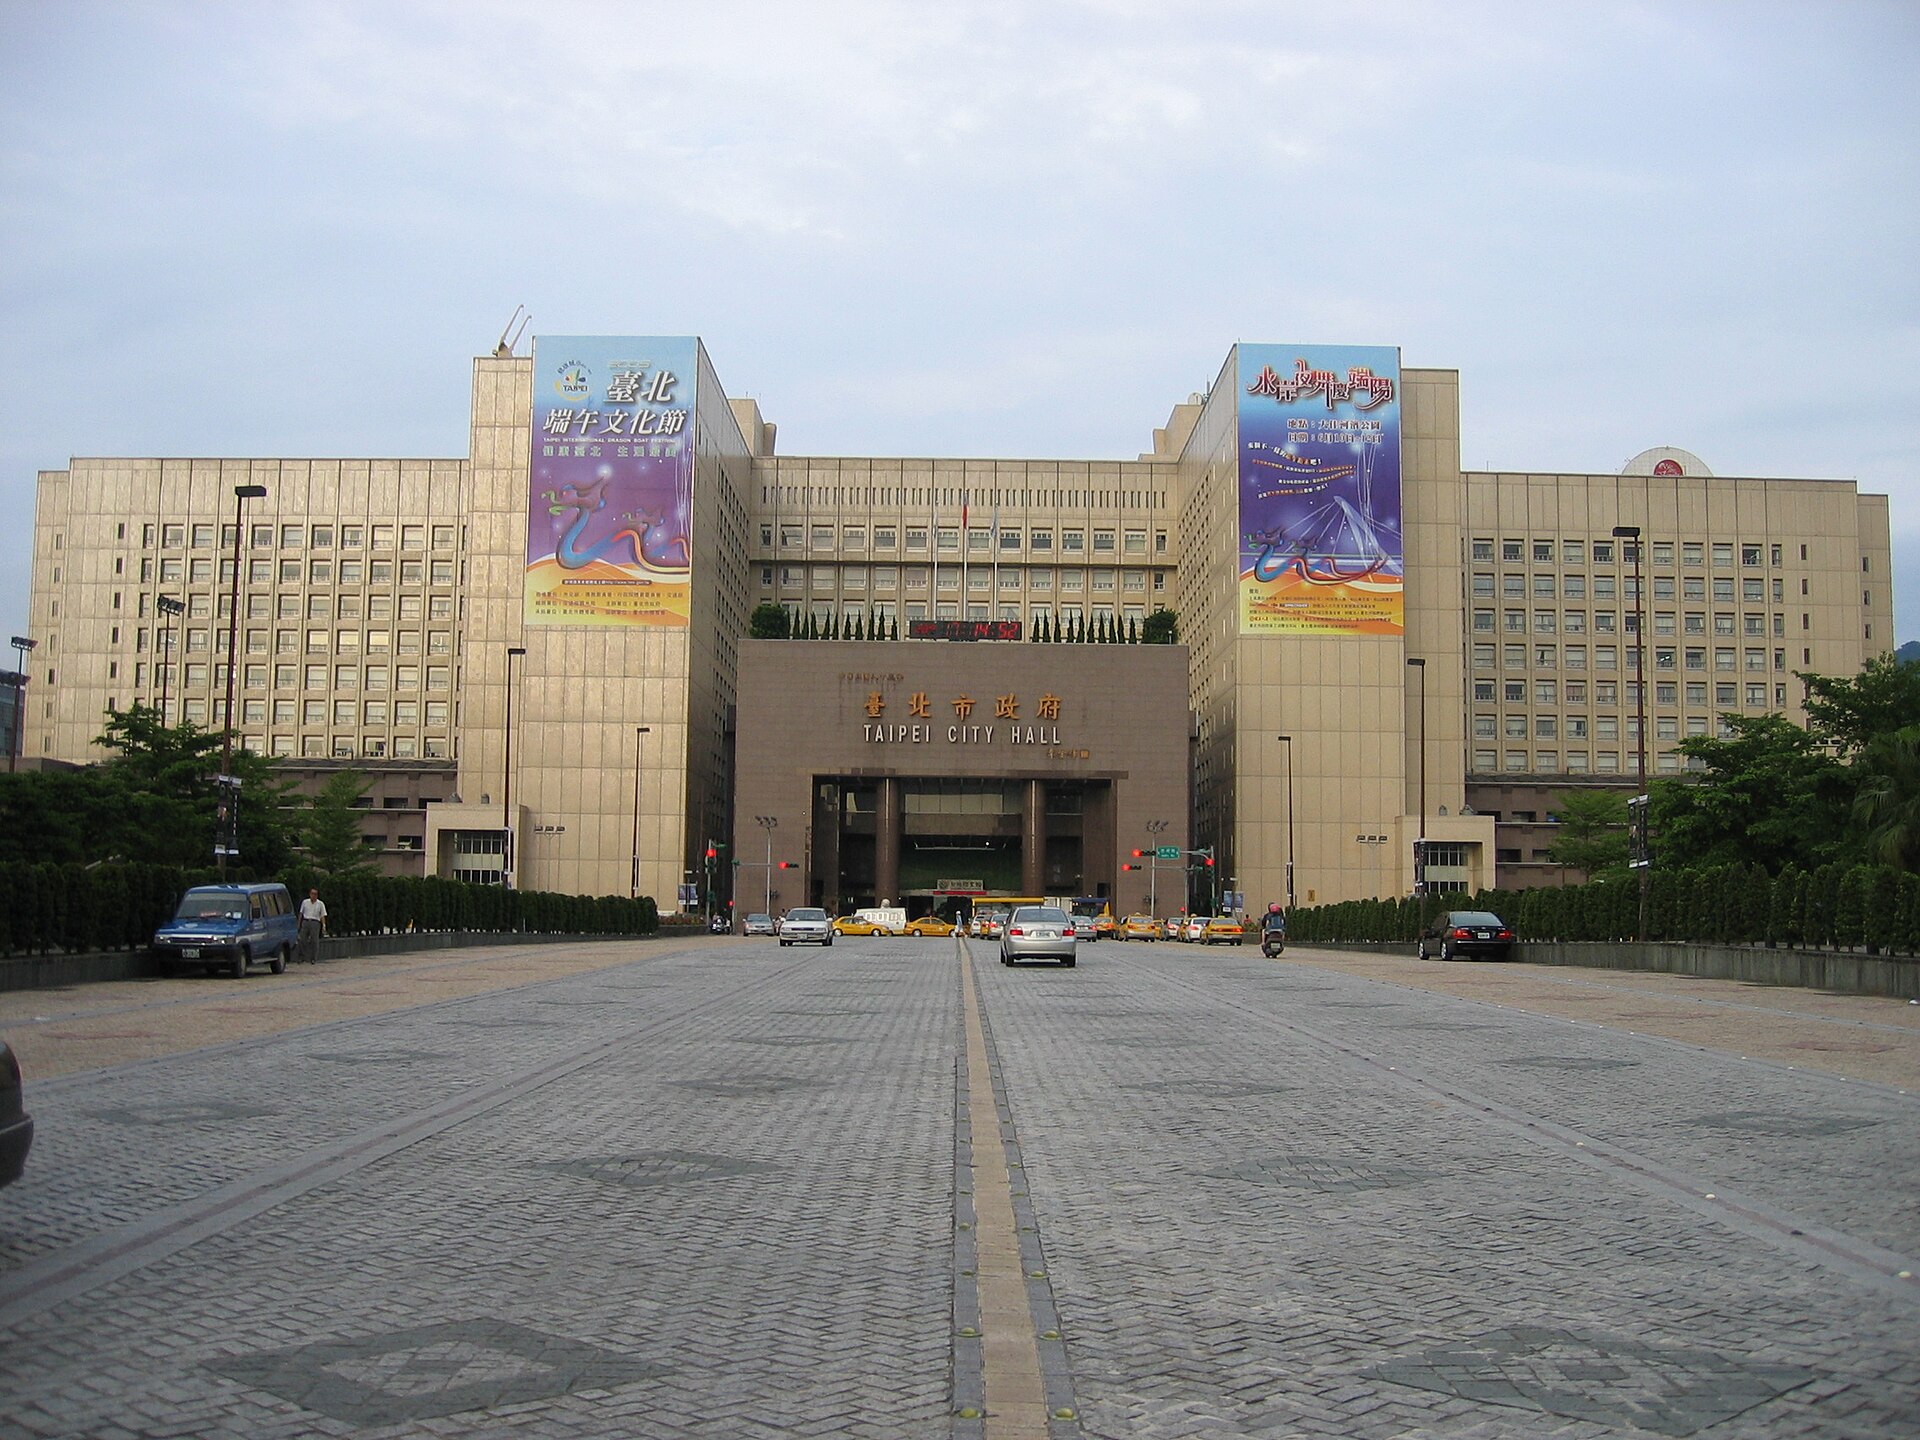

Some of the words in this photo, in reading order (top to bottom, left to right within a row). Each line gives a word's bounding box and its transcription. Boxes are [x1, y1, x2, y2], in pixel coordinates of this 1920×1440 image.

[603, 370, 676, 403] 臺北
[543, 408, 687, 435] 端午文化節
[864, 691, 1062, 721] 臺北市政府
[863, 724, 931, 743] TAIPEI
[947, 725, 995, 744] CITY
[1011, 726, 1062, 745] HALL
